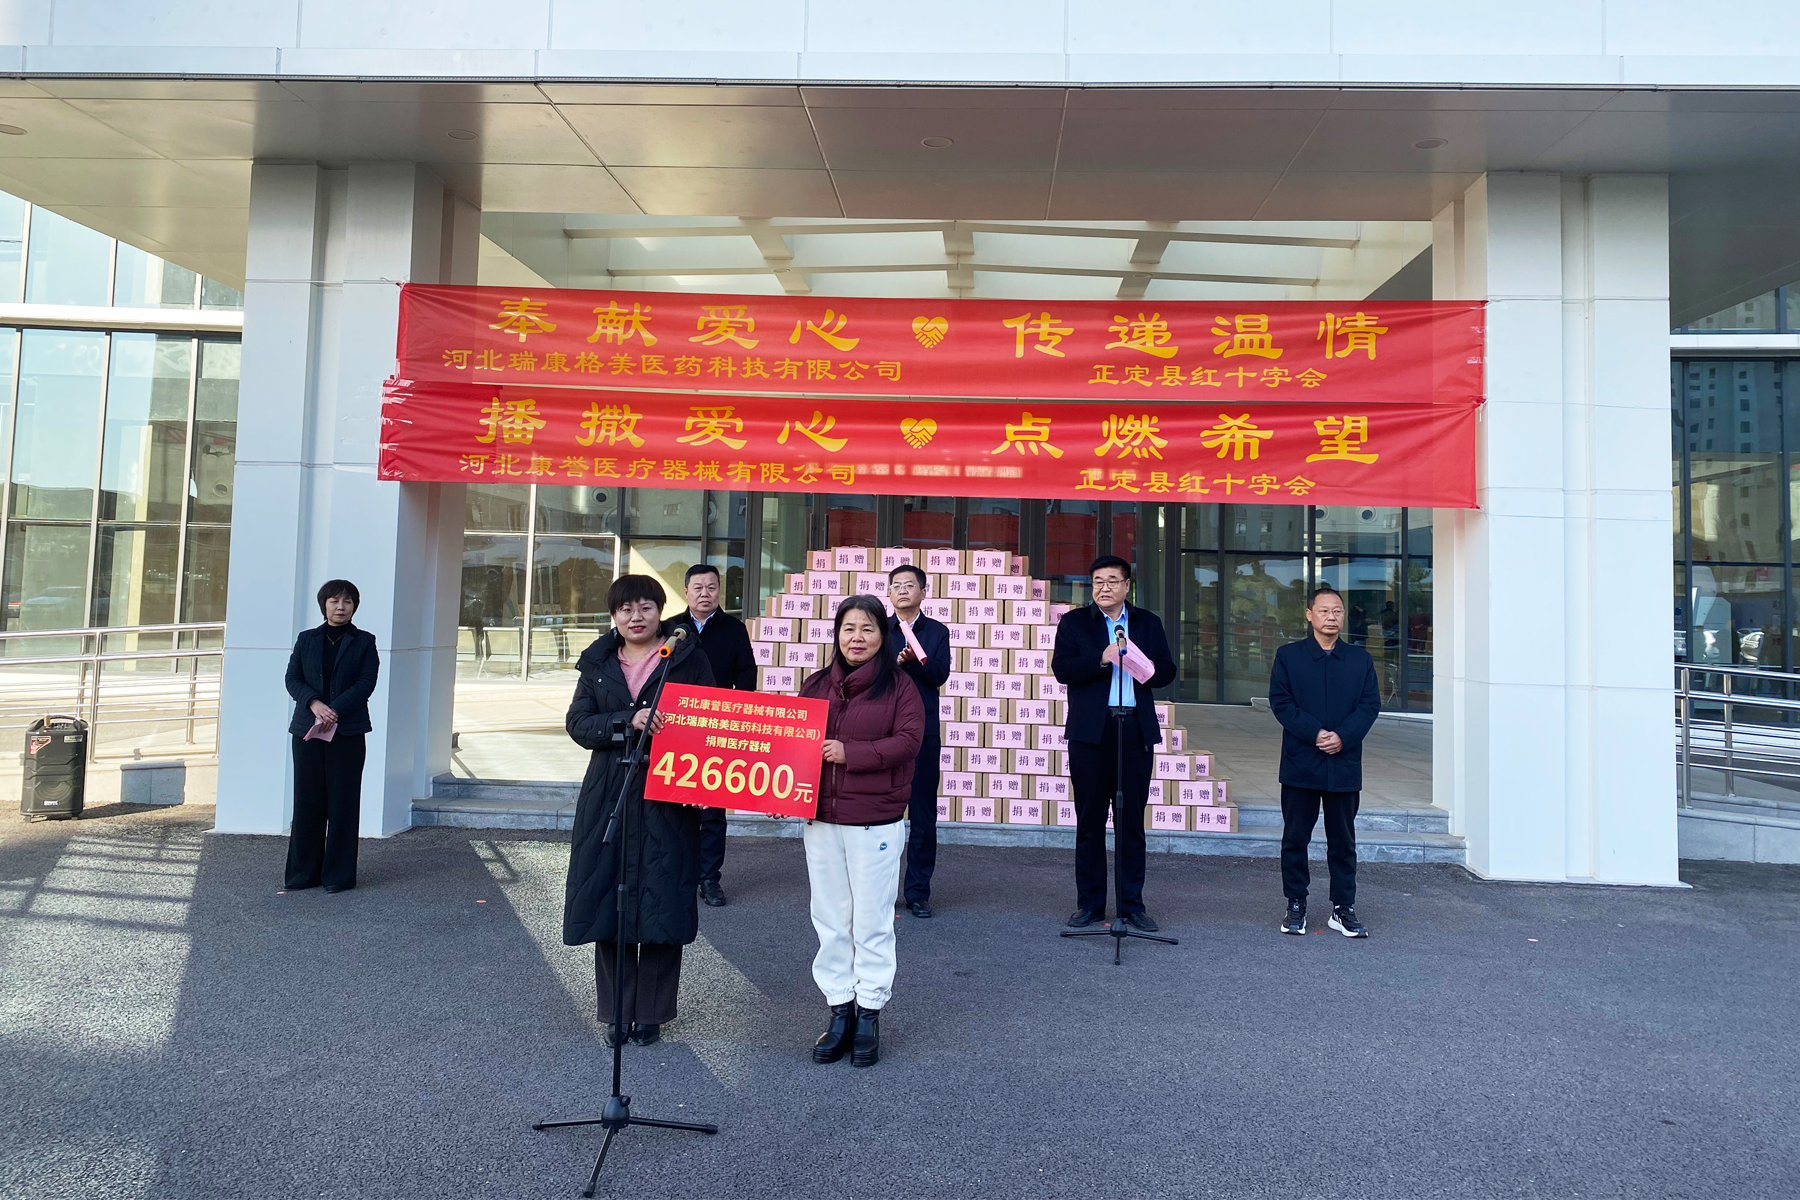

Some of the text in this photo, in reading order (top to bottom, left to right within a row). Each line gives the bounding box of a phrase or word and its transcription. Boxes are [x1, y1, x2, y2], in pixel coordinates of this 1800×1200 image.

[488, 296, 1389, 360] 奉献爱心 传递温情
[441, 349, 902, 382] 河北瑞康格美医药科技有限公司
[1088, 364, 1328, 388] 正定县红十字会
[475, 396, 1380, 465] 播撒爱心 点燃希望
[459, 453, 856, 486] 河北康誉医疗器械有限公司
[1074, 469, 1316, 496] 正定县红十字会
[839, 554, 864, 565] 捐赠
[931, 555, 956, 566] 捐赠
[976, 556, 1002, 568] 捐赠
[812, 579, 838, 590] 捐赠
[859, 580, 885, 591] 捐赠
[951, 580, 977, 592] 捐赠
[997, 583, 1023, 594] 捐赠
[784, 600, 810, 611] 捐赠
[923, 606, 949, 617] 捐赠
[969, 606, 994, 617] 捐赠
[1016, 606, 1042, 617] 捐赠
[763, 626, 789, 637] 捐赠
[950, 629, 976, 640] 捐赠
[994, 630, 1020, 641] 捐赠
[789, 651, 814, 662] 捐赠
[973, 657, 999, 668] 捐赠
[1018, 657, 1044, 669] 捐赠
[766, 675, 792, 686] 捐赠
[949, 679, 975, 691] 捐赠
[995, 680, 1021, 691] 捐赠
[678, 696, 808, 721] 河北康誉医疗器械有限公司
[971, 705, 997, 717] 捐赠
[1020, 707, 1046, 718] 捐赠
[949, 730, 975, 741] 捐赠
[995, 730, 1021, 741] 捐赠
[705, 735, 771, 753] 捐赠医疗器械
[971, 754, 997, 765] 捐赠
[1019, 755, 1045, 767] 捐赠
[1159, 761, 1186, 773] 捐赠
[652, 751, 813, 803] 426600元
[946, 779, 973, 791] 捐赠
[992, 780, 1019, 791] 捐赠
[1039, 782, 1066, 794] 捐赠
[1182, 789, 1210, 800] 捐赠
[965, 805, 991, 817] 捐赠
[1012, 805, 1039, 818] 捐赠
[1155, 811, 1182, 823] 捐赠
[1200, 812, 1227, 824] 捐赠
